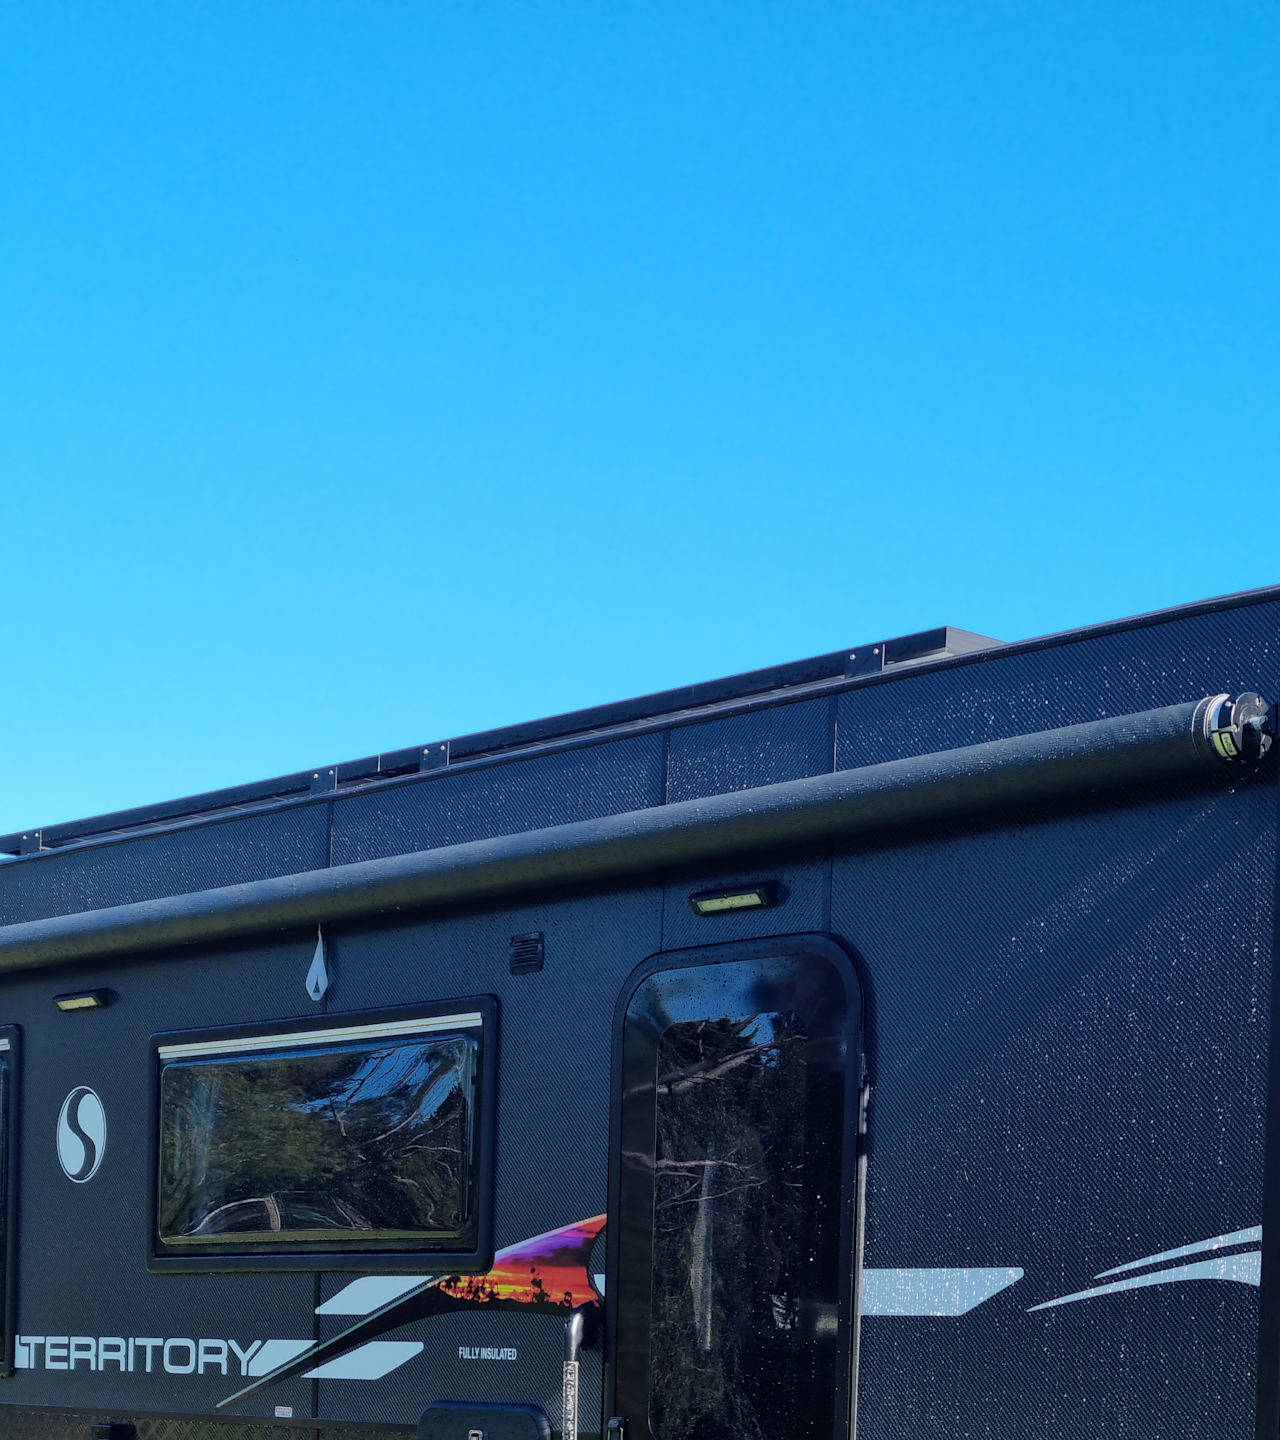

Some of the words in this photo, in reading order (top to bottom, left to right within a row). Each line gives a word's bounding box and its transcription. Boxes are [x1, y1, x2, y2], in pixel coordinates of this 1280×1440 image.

[20, 1336, 261, 1376] TERRITORY
[458, 1346, 479, 1359] FULLY
[480, 1347, 517, 1360] INSULATED
